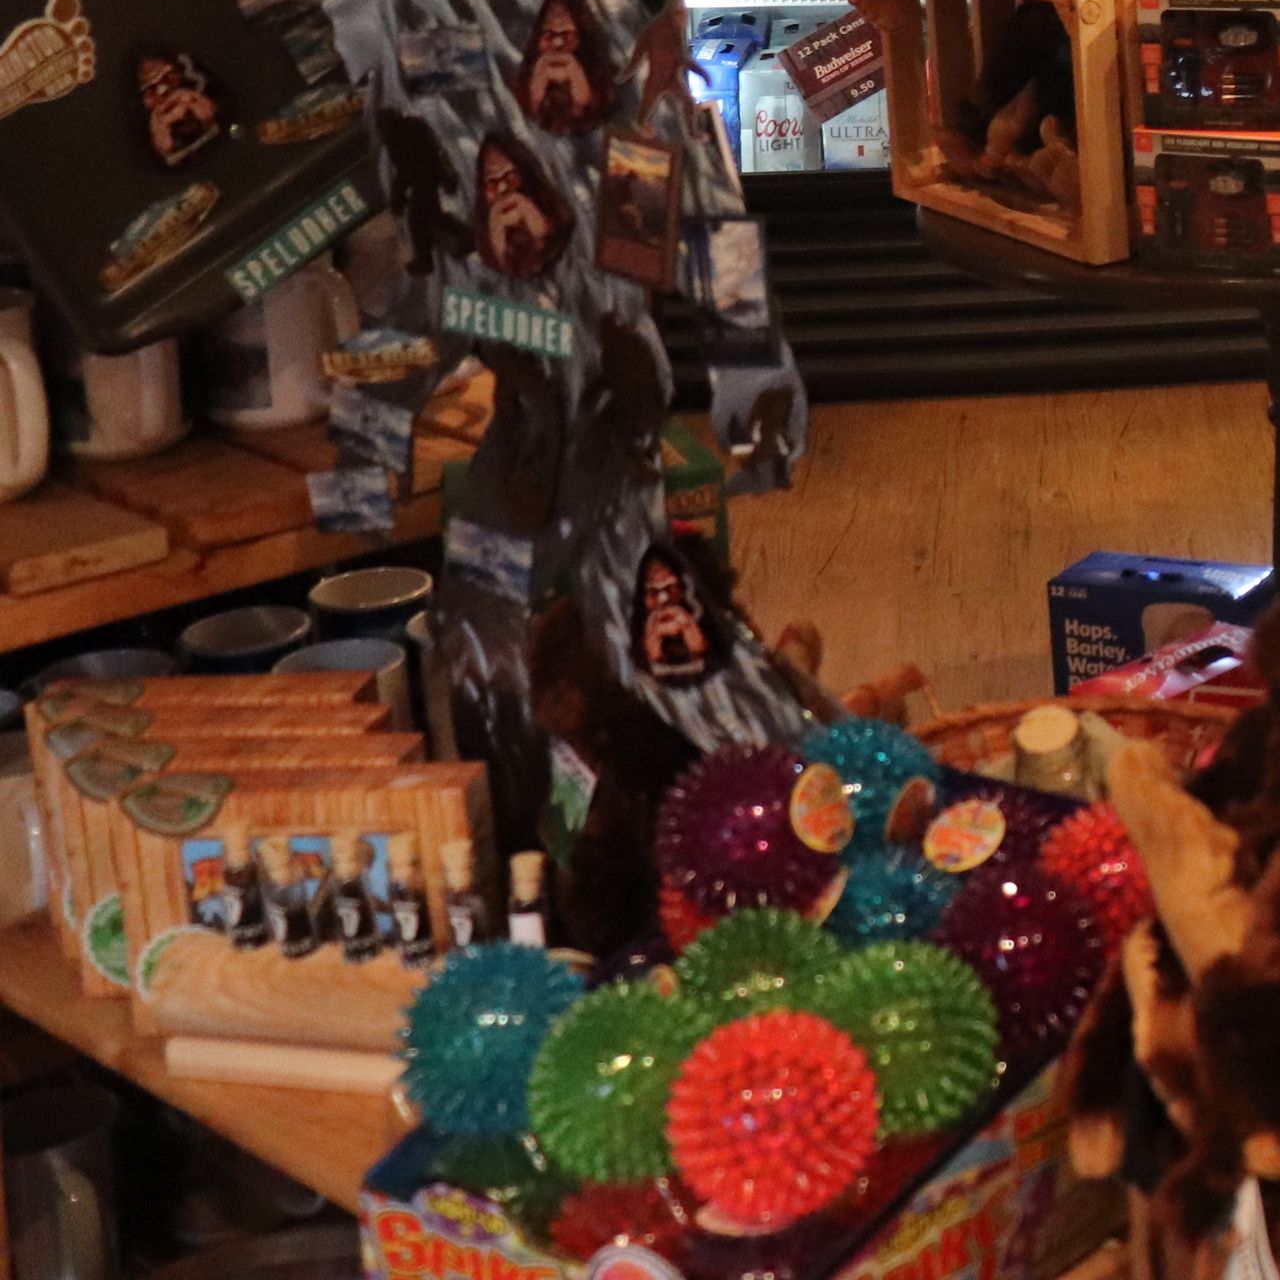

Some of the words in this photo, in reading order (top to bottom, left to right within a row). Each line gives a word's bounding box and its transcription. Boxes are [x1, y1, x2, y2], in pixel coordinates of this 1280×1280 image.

[798, 47, 814, 60] 12
[813, 31, 839, 51] Pack
[839, 17, 866, 35] Cans
[813, 39, 873, 80] Budweiser
[850, 79, 876, 99] 9.50
[829, 125, 888, 139] ULTRA
[1050, 586, 1065, 597] 12
[1065, 618, 1117, 640] Hops.
[1066, 637, 1132, 662] Barley.
